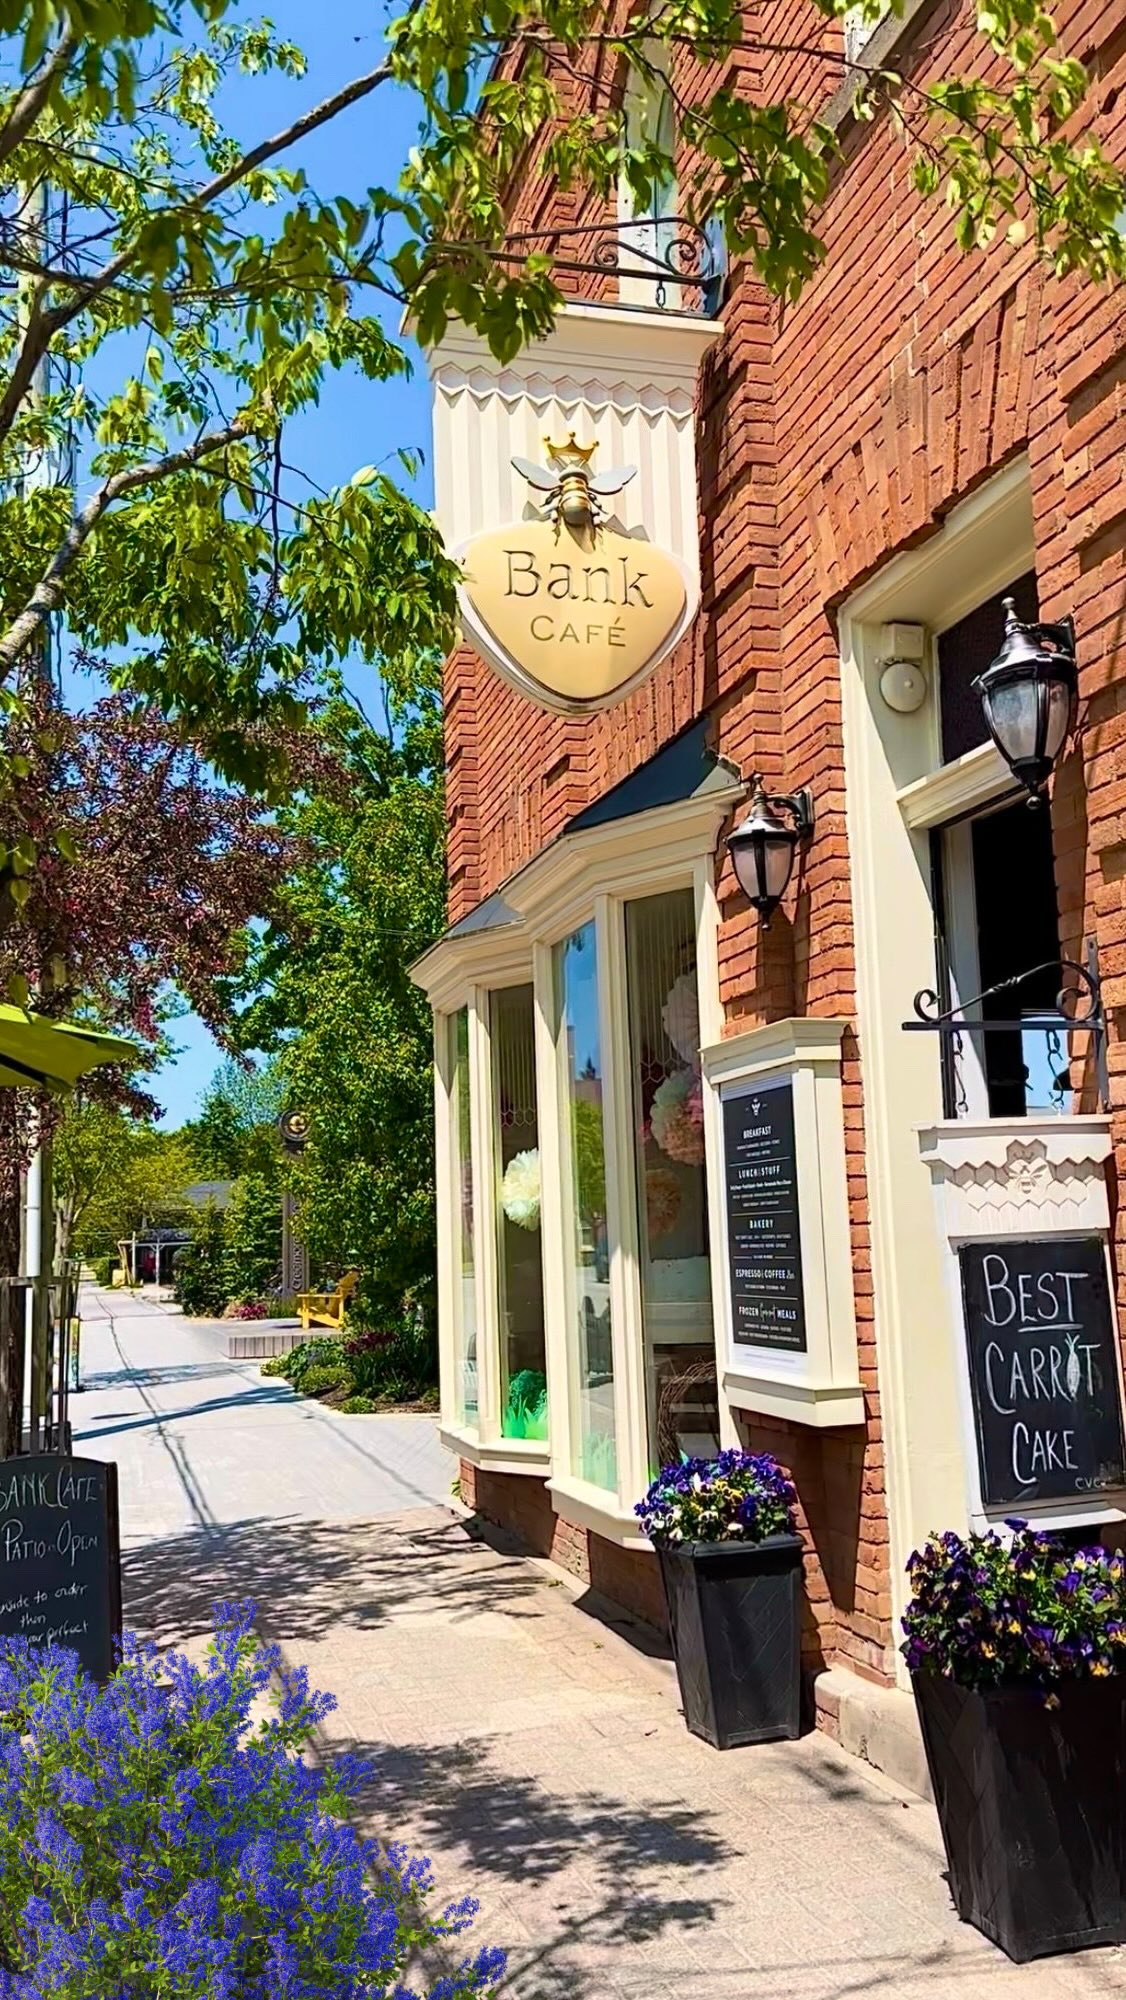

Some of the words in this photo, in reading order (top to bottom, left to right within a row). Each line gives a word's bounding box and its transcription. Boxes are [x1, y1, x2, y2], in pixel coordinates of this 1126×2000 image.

[503, 549, 654, 608] Bank
[530, 614, 627, 648] CAFÉ
[743, 1125, 772, 1139] BREAKFAST
[761, 1165, 780, 1176] STUFF
[749, 1219, 774, 1229] BAKERY
[735, 1268, 761, 1278] ESPRESSO
[764, 1269, 785, 1279] COFFEE
[982, 1253, 1089, 1326] BEST
[738, 1306, 759, 1317] FROZEN
[776, 1309, 797, 1320] MEALS
[1012, 1421, 1079, 1485] CAKE
[33, 1589, 48, 1604] to
[54, 1582, 88, 1598] order
